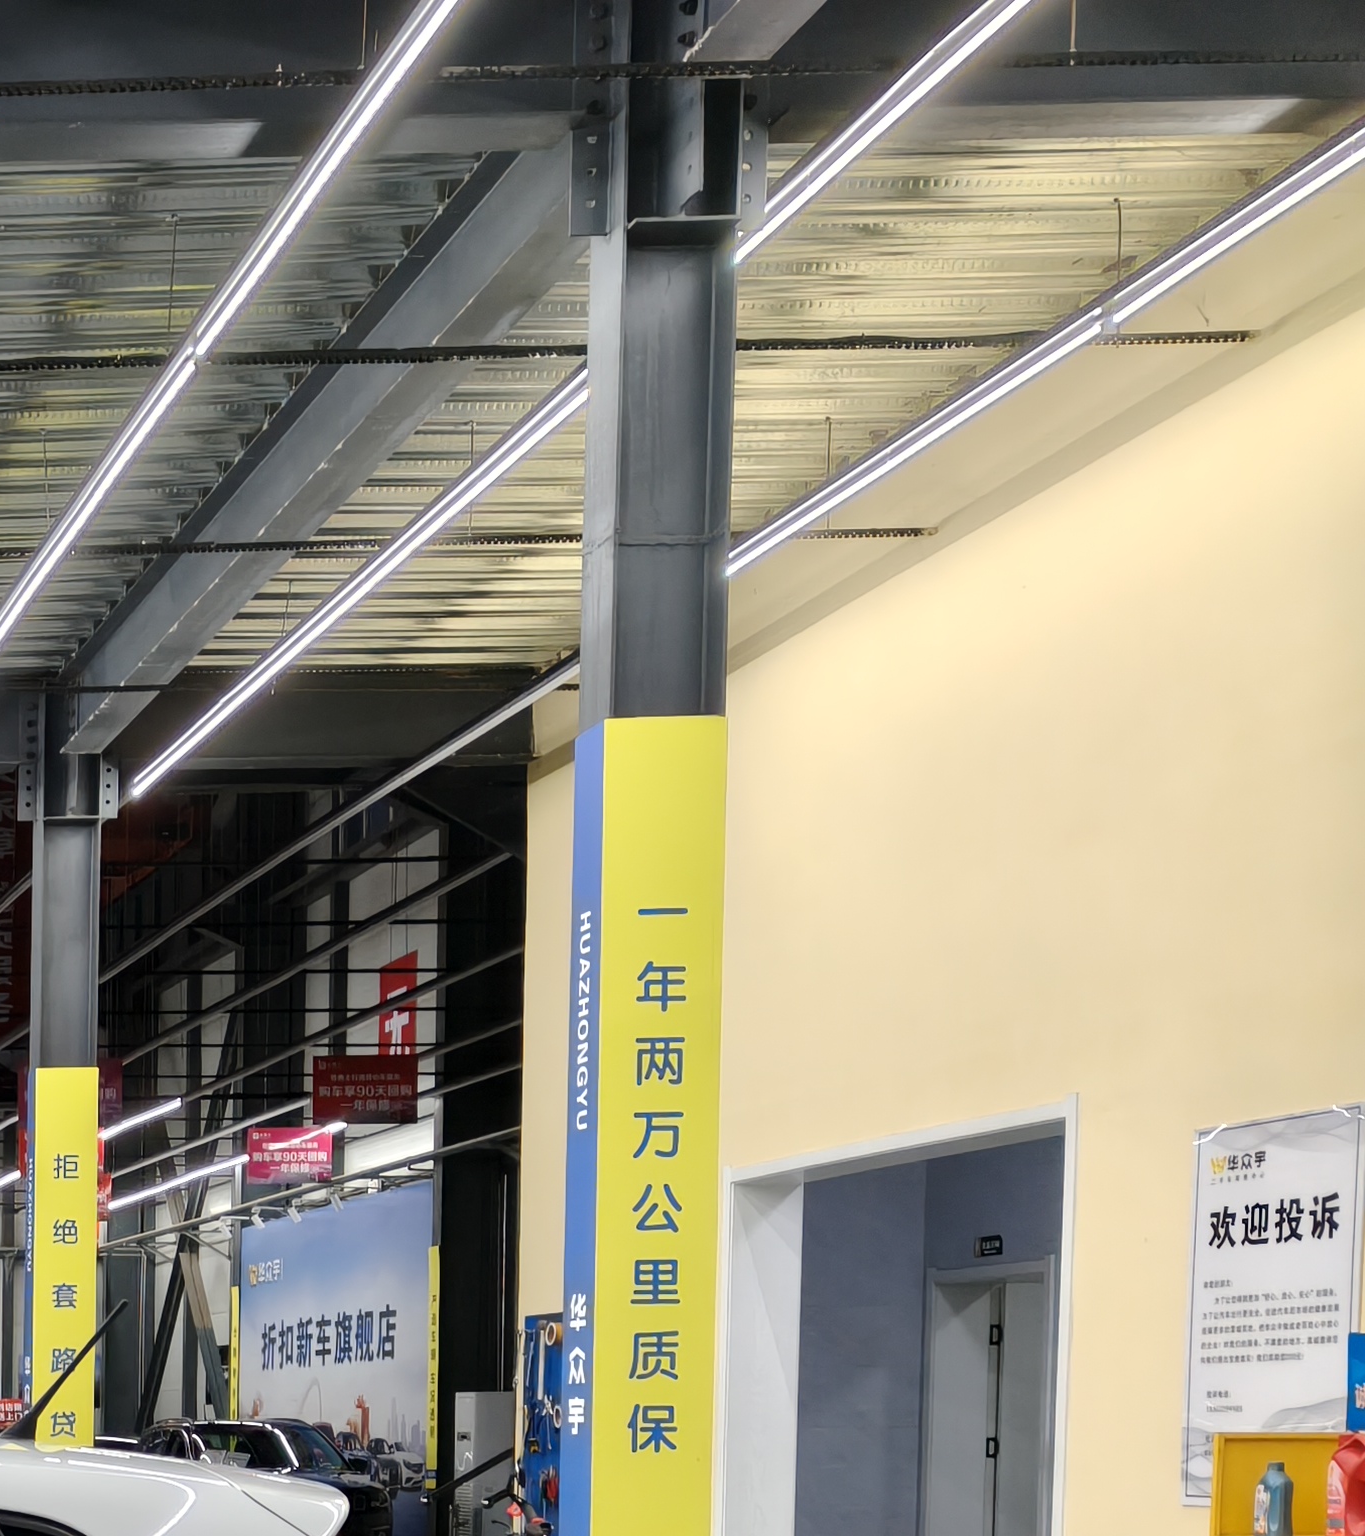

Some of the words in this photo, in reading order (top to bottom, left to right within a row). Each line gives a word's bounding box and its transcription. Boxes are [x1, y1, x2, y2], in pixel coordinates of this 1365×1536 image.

[574, 910, 592, 1132] HUAZHONGYU
[319, 1084, 412, 1097] 购车享90天回购
[253, 1151, 327, 1162] 购车享90天回购
[627, 905, 689, 1455] 一年两万公里质保
[1227, 1151, 1267, 1171] 华众宇
[1208, 1192, 1340, 1249] 欢迎投诉
[50, 1152, 79, 1439] 拒绝套路贷
[261, 1304, 397, 1371] 折扣新车旗舰店
[568, 1293, 587, 1435] 华众宇
